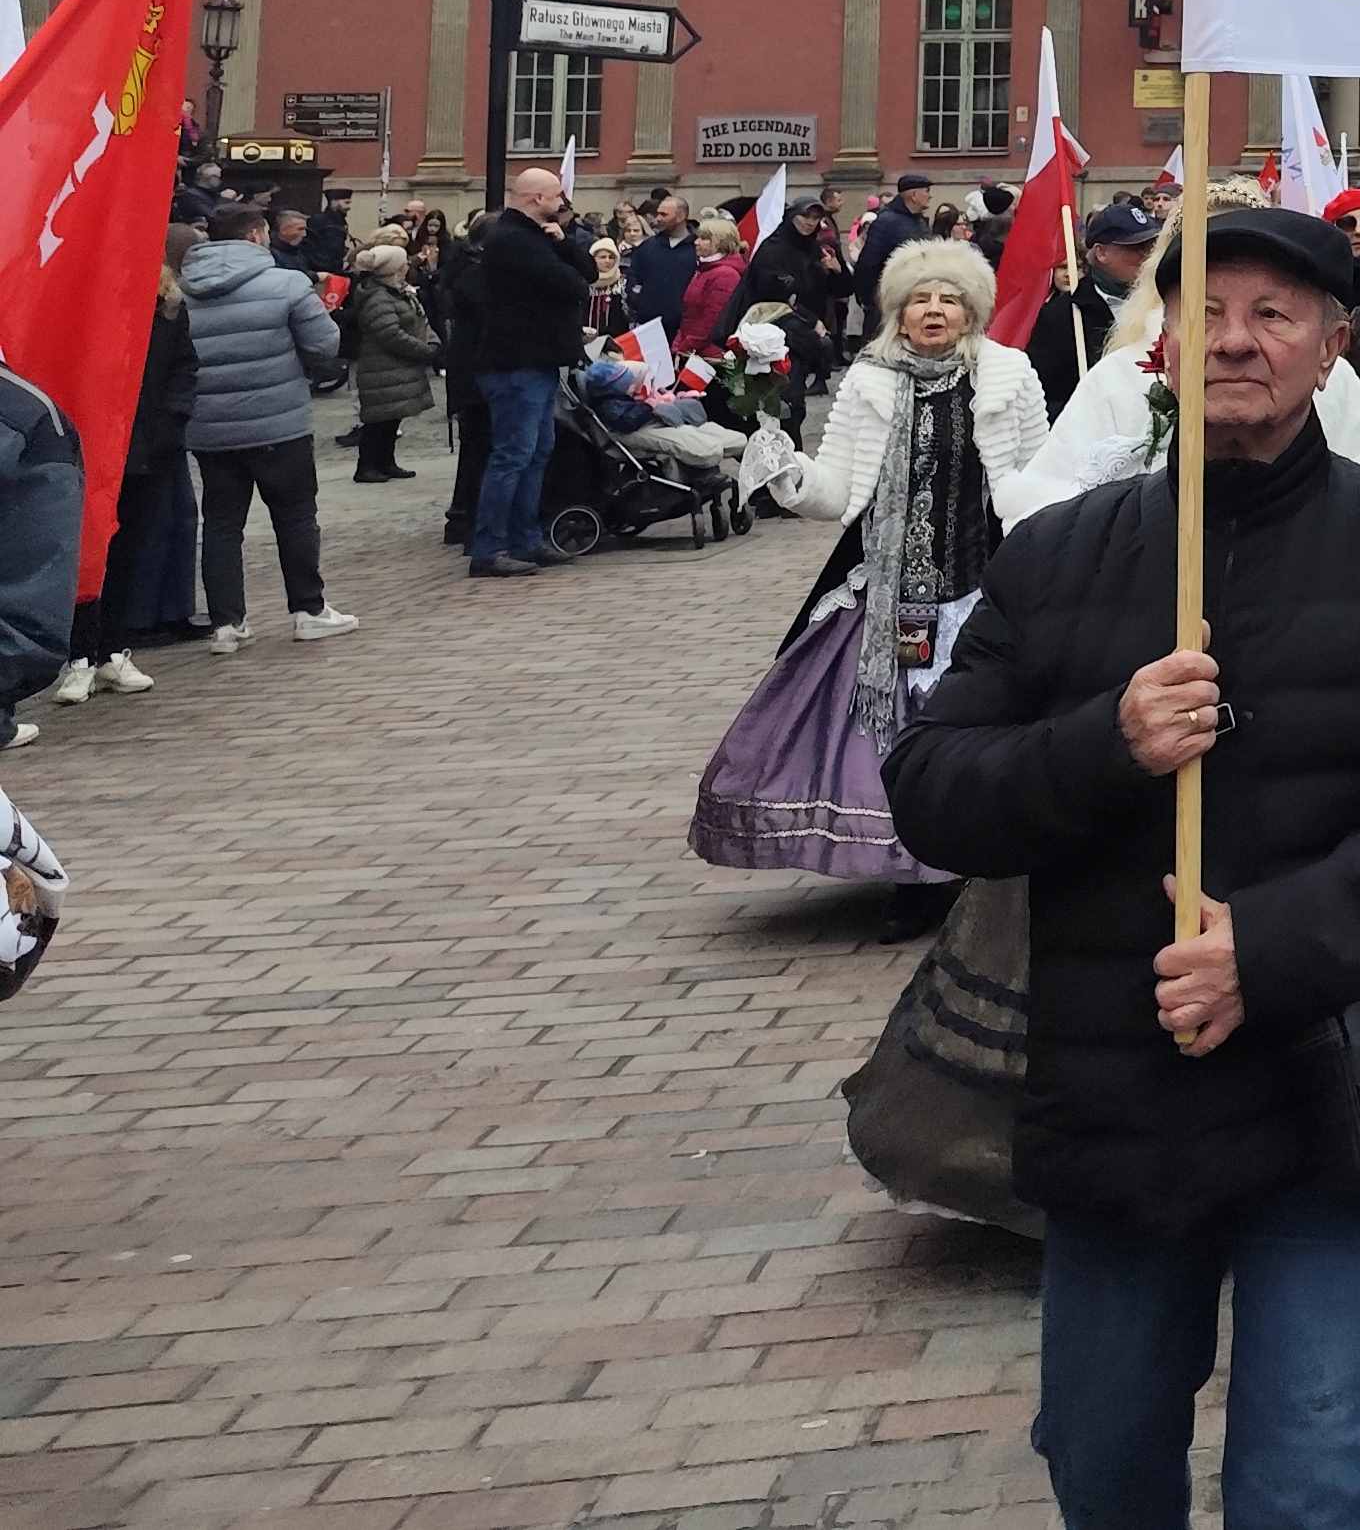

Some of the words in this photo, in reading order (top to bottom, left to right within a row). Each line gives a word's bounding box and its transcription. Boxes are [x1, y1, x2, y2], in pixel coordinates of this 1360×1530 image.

[530, 7, 569, 25] Ratusz
[572, 11, 625, 32] Głównego
[628, 17, 662, 34] Miasta
[559, 29, 573, 40] The
[575, 30, 594, 41] Main
[597, 32, 617, 44] Town
[619, 34, 634, 45] Hall
[702, 123, 729, 139] THE
[732, 120, 811, 138] LEGENDARY
[702, 143, 735, 158] RED
[739, 143, 773, 157] DOG
[777, 142, 811, 157] BAR
